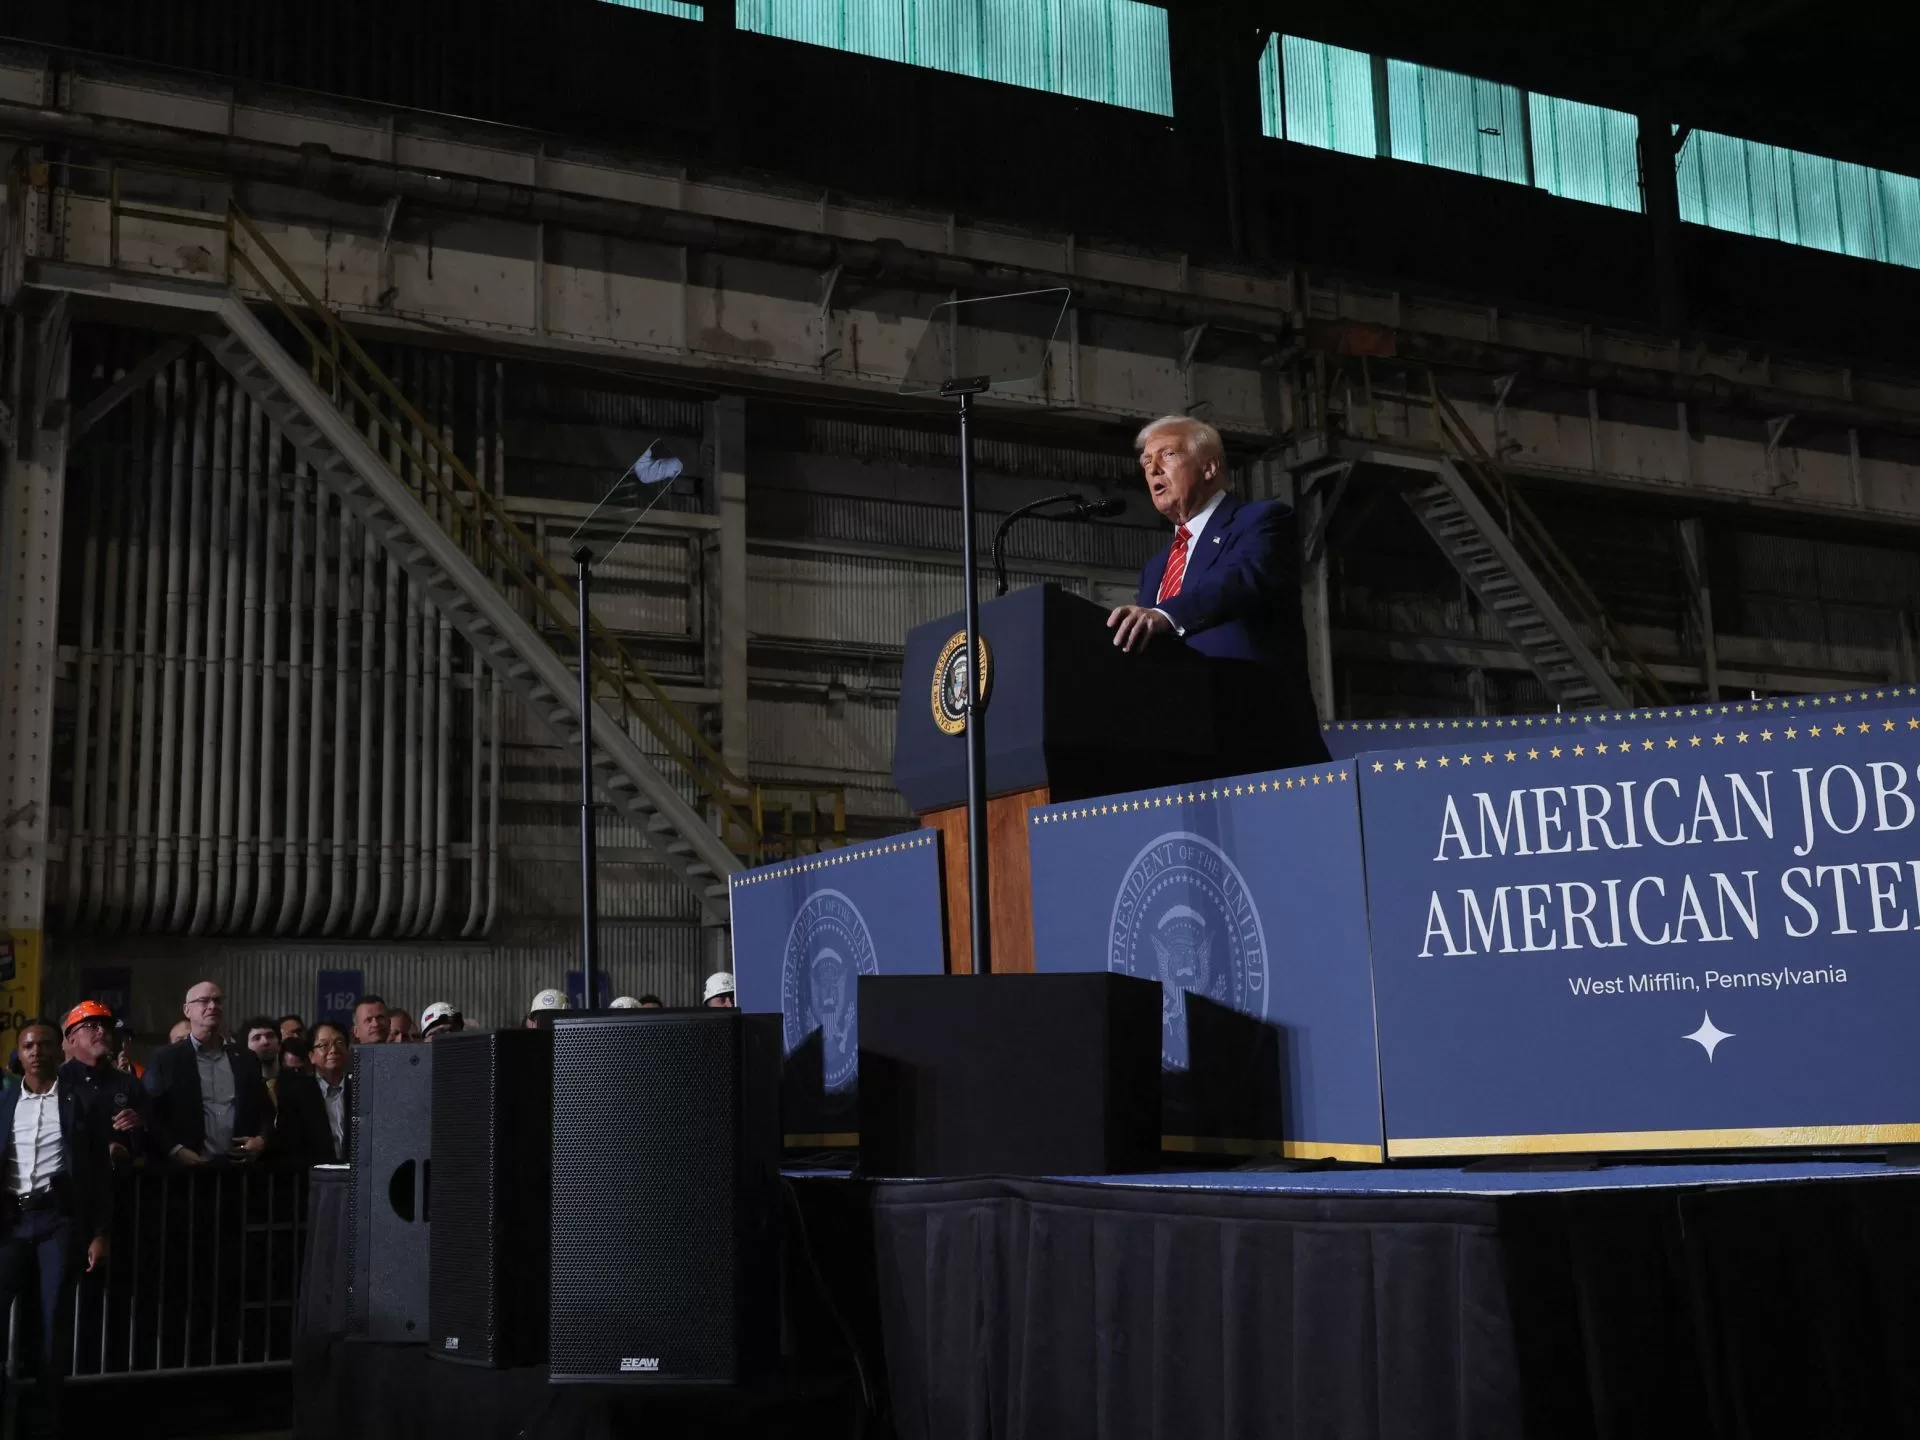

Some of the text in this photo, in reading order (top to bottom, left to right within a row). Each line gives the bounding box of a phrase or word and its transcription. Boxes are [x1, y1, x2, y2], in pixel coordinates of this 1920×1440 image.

[934, 633, 962, 687] PRESIDENT
[1433, 761, 1920, 861] AMERICAN JOB
[784, 898, 823, 1000] PRESIDENT
[1113, 843, 1264, 992] PRESIDENT OF THE UNITED
[1418, 860, 1920, 958] AMERICAN STE
[323, 991, 356, 1011] 162
[1568, 965, 1848, 996] West Mifflin, Pennsylvania
